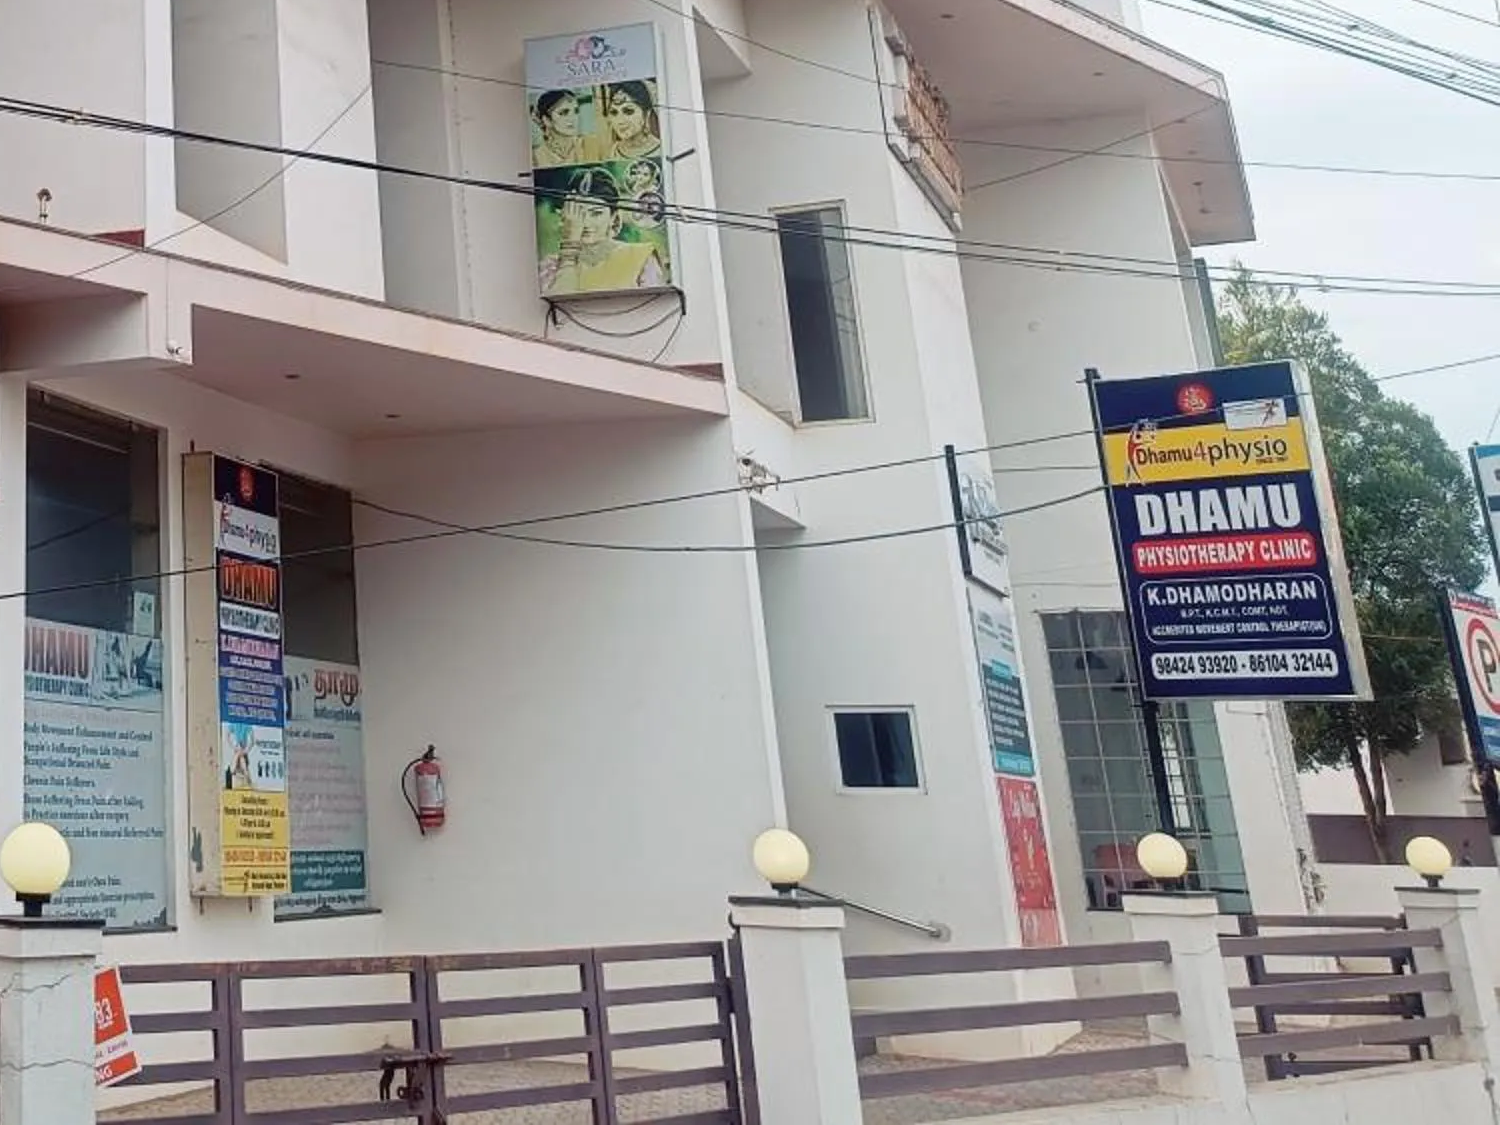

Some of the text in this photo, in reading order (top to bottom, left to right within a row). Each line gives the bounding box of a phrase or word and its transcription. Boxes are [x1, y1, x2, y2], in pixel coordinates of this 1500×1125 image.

[566, 58, 616, 76] SARA
[1135, 436, 1288, 467] Dhamu4physio
[1135, 482, 1301, 536] DHAMU
[1137, 538, 1312, 568] PHYSIOTHERAPY CLINIC
[1147, 581, 1317, 606] K.DHAMODHARAN
[1155, 655, 1195, 675] 98424
[1197, 653, 1237, 674] 93920
[1250, 652, 1288, 673] 86104
[1293, 650, 1333, 672] 32144
[1476, 639, 1497, 694] P
